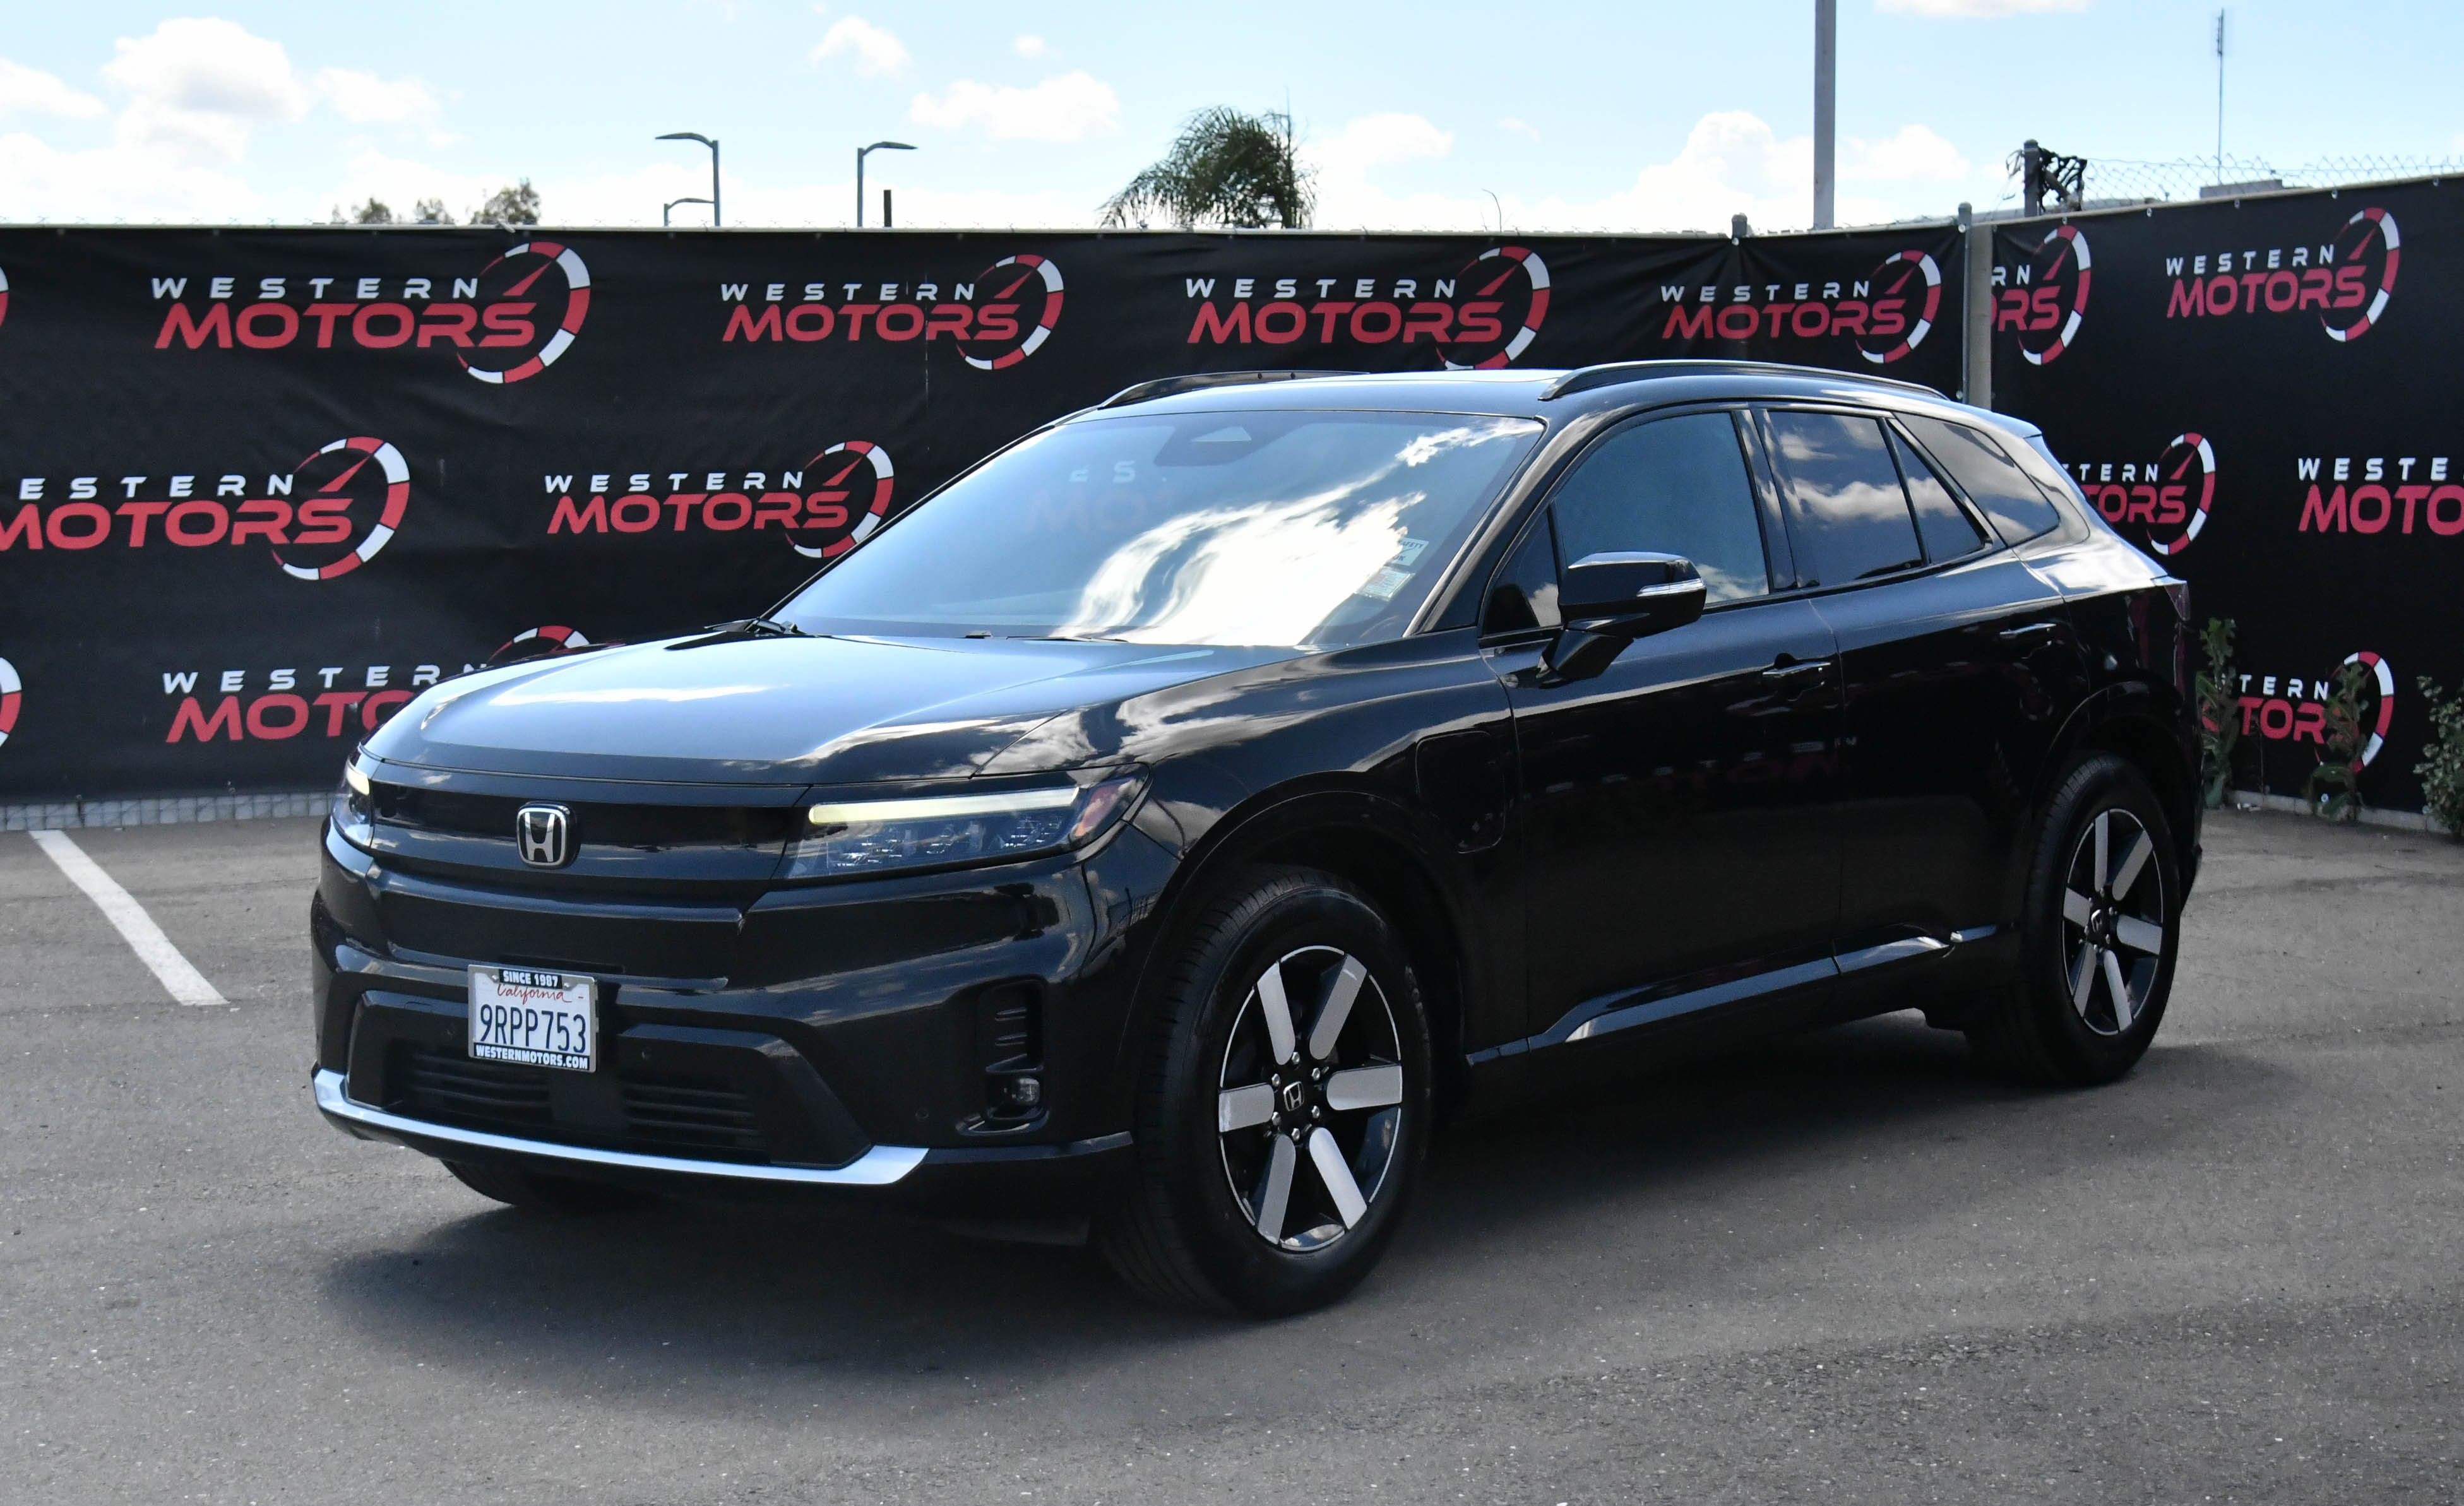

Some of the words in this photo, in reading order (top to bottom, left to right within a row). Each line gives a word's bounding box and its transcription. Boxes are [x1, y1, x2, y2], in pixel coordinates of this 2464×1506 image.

[2166, 244, 2334, 276] WESTERN
[152, 277, 478, 299] WESTERN
[721, 283, 974, 301] WESTERN
[1186, 278, 1455, 298] WESTERN
[1661, 281, 1869, 302] WESTERN
[2167, 266, 2366, 317] MOTORS
[155, 302, 536, 349] MOTORS
[723, 304, 1020, 342] MOTORS
[1187, 301, 1504, 343] MOTORS
[1663, 299, 1905, 339] MOTORS
[2062, 463, 2158, 482] TERN
[2298, 458, 2464, 481] WESTE
[545, 471, 803, 494] WESTERN
[547, 491, 849, 534] MOTORS
[2214, 673, 2328, 701] TERN
[503, 970, 532, 985] SINCE
[534, 973, 558, 988] 1987
[497, 983, 572, 1005] California
[480, 1004, 586, 1053] 9RPP753
[475, 1045, 588, 1070] WESTERNMOTORS.COM
